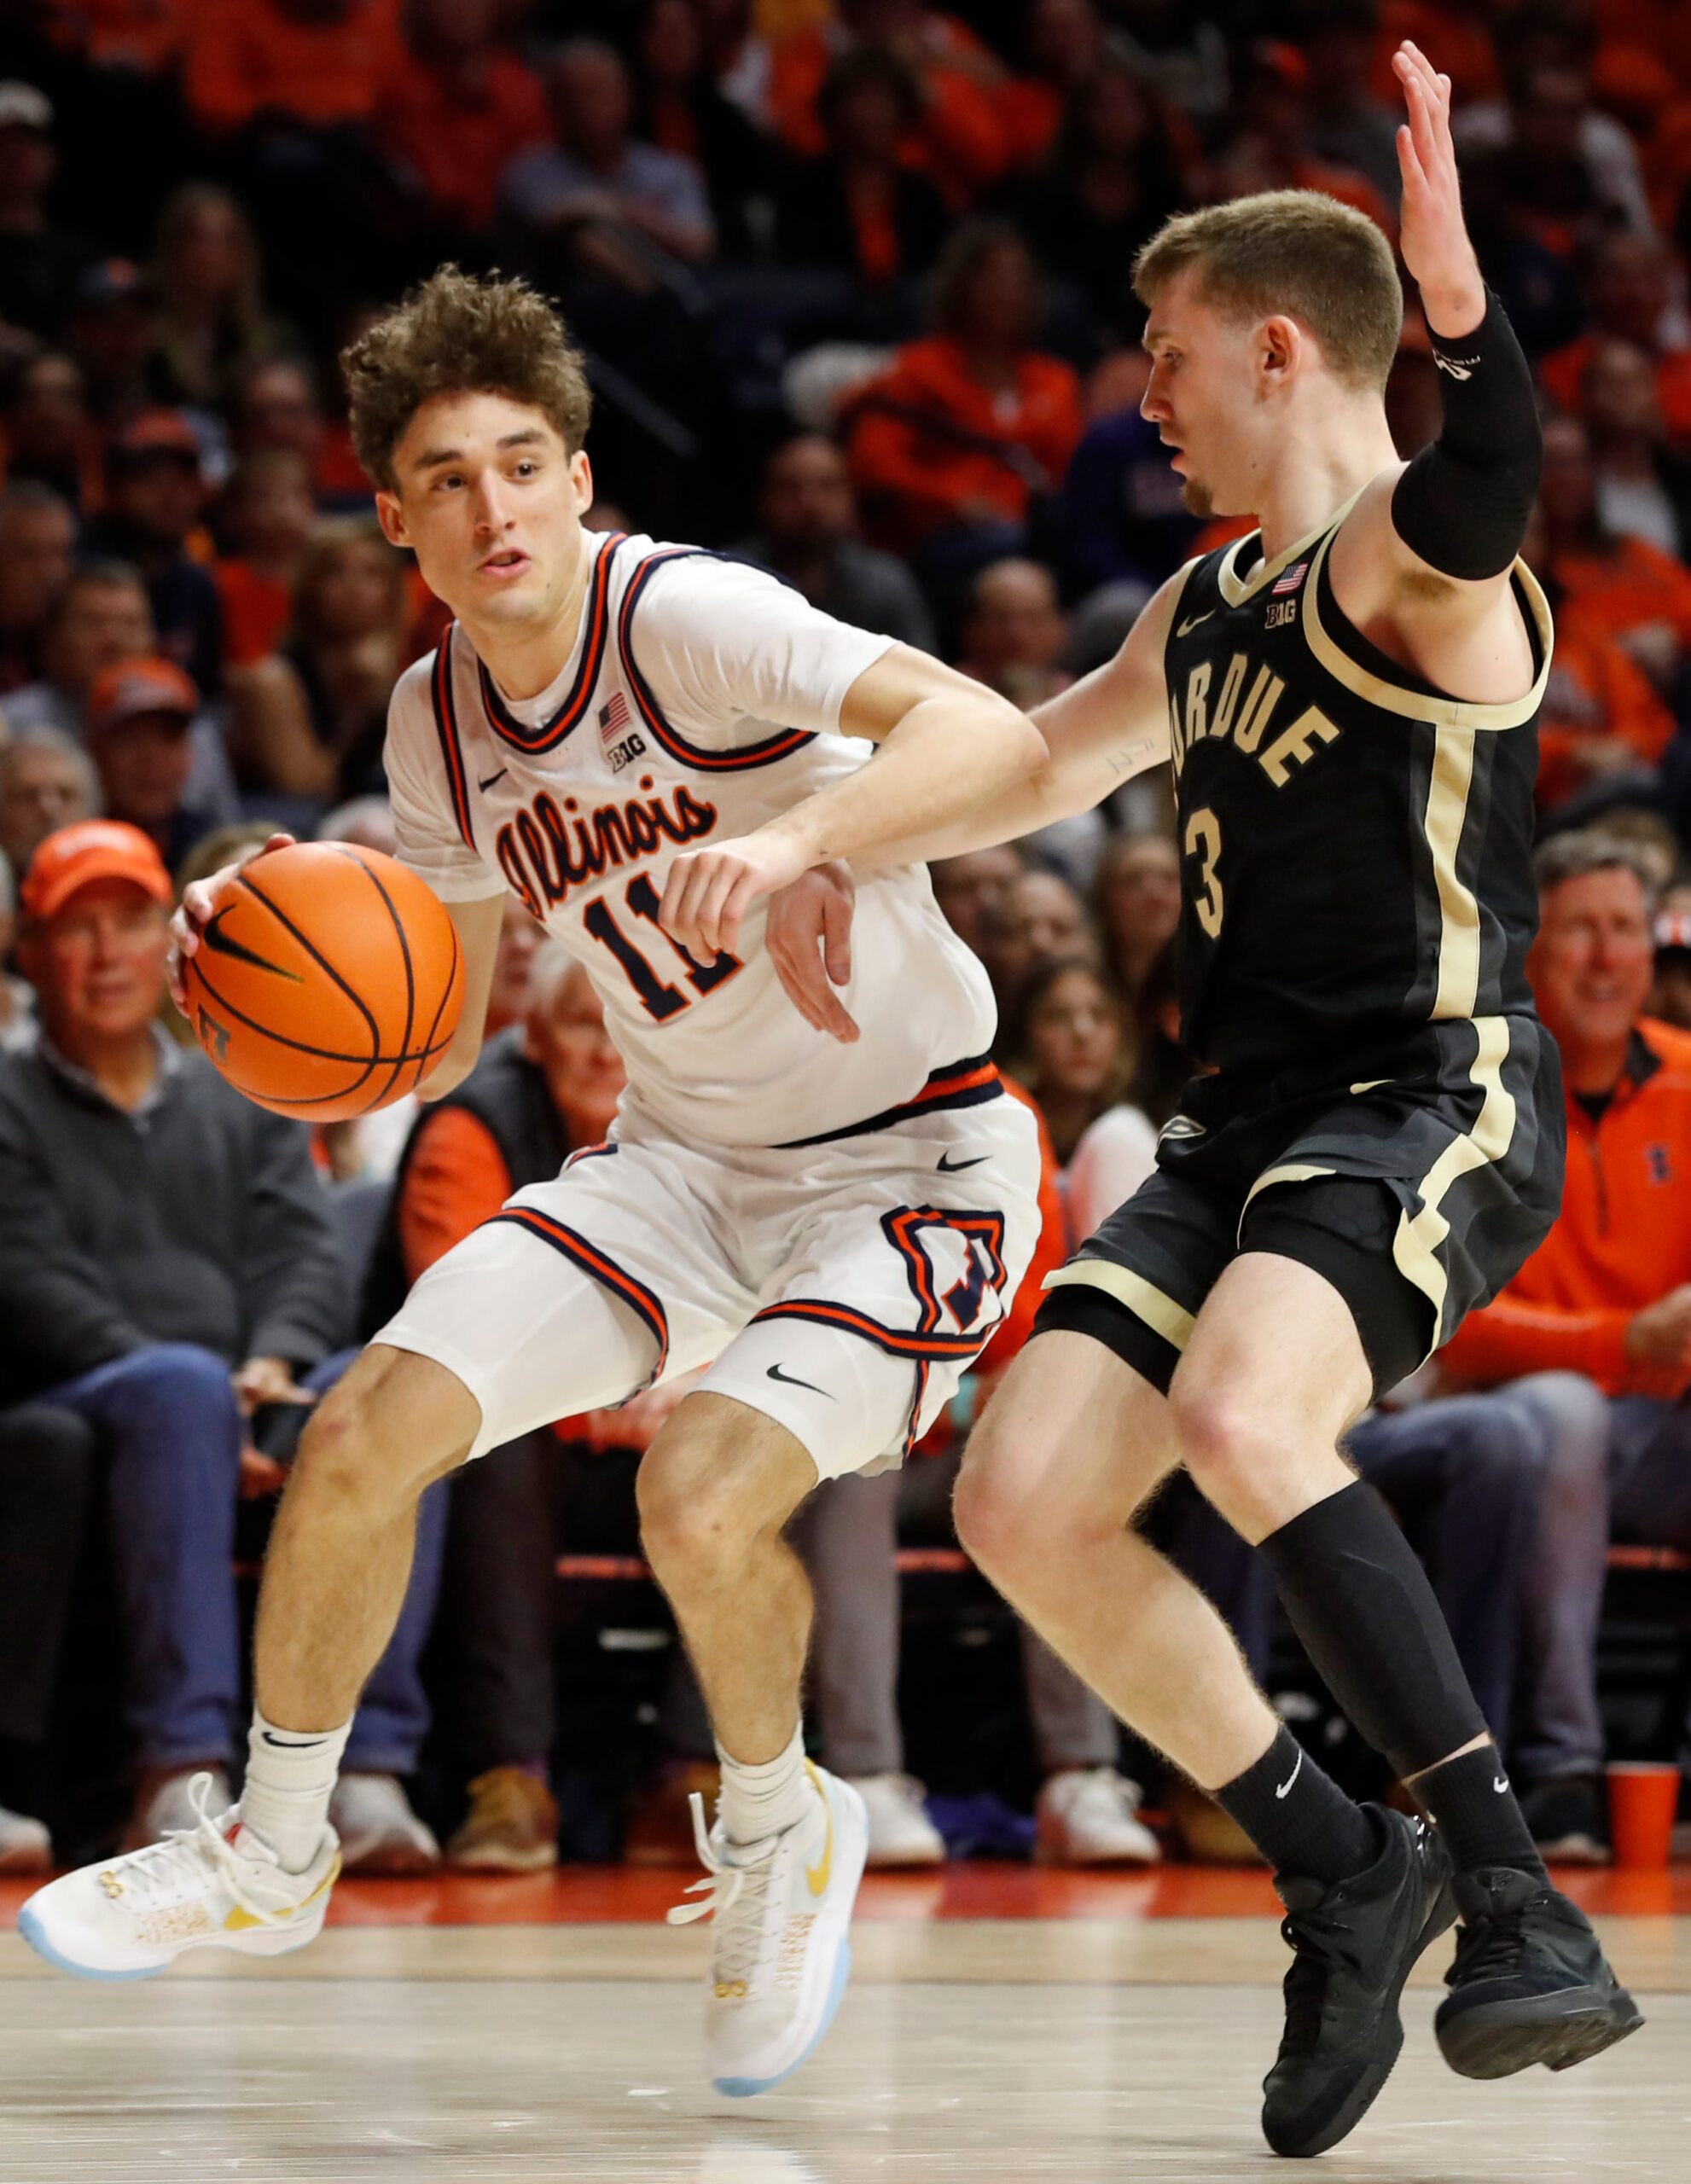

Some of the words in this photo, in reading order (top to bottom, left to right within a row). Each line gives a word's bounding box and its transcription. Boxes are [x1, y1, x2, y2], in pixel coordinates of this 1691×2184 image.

[1168, 653, 1342, 789] URDUE
[496, 774, 718, 922] Illinois
[1185, 807, 1224, 939] 3
[583, 870, 746, 1020] 11
